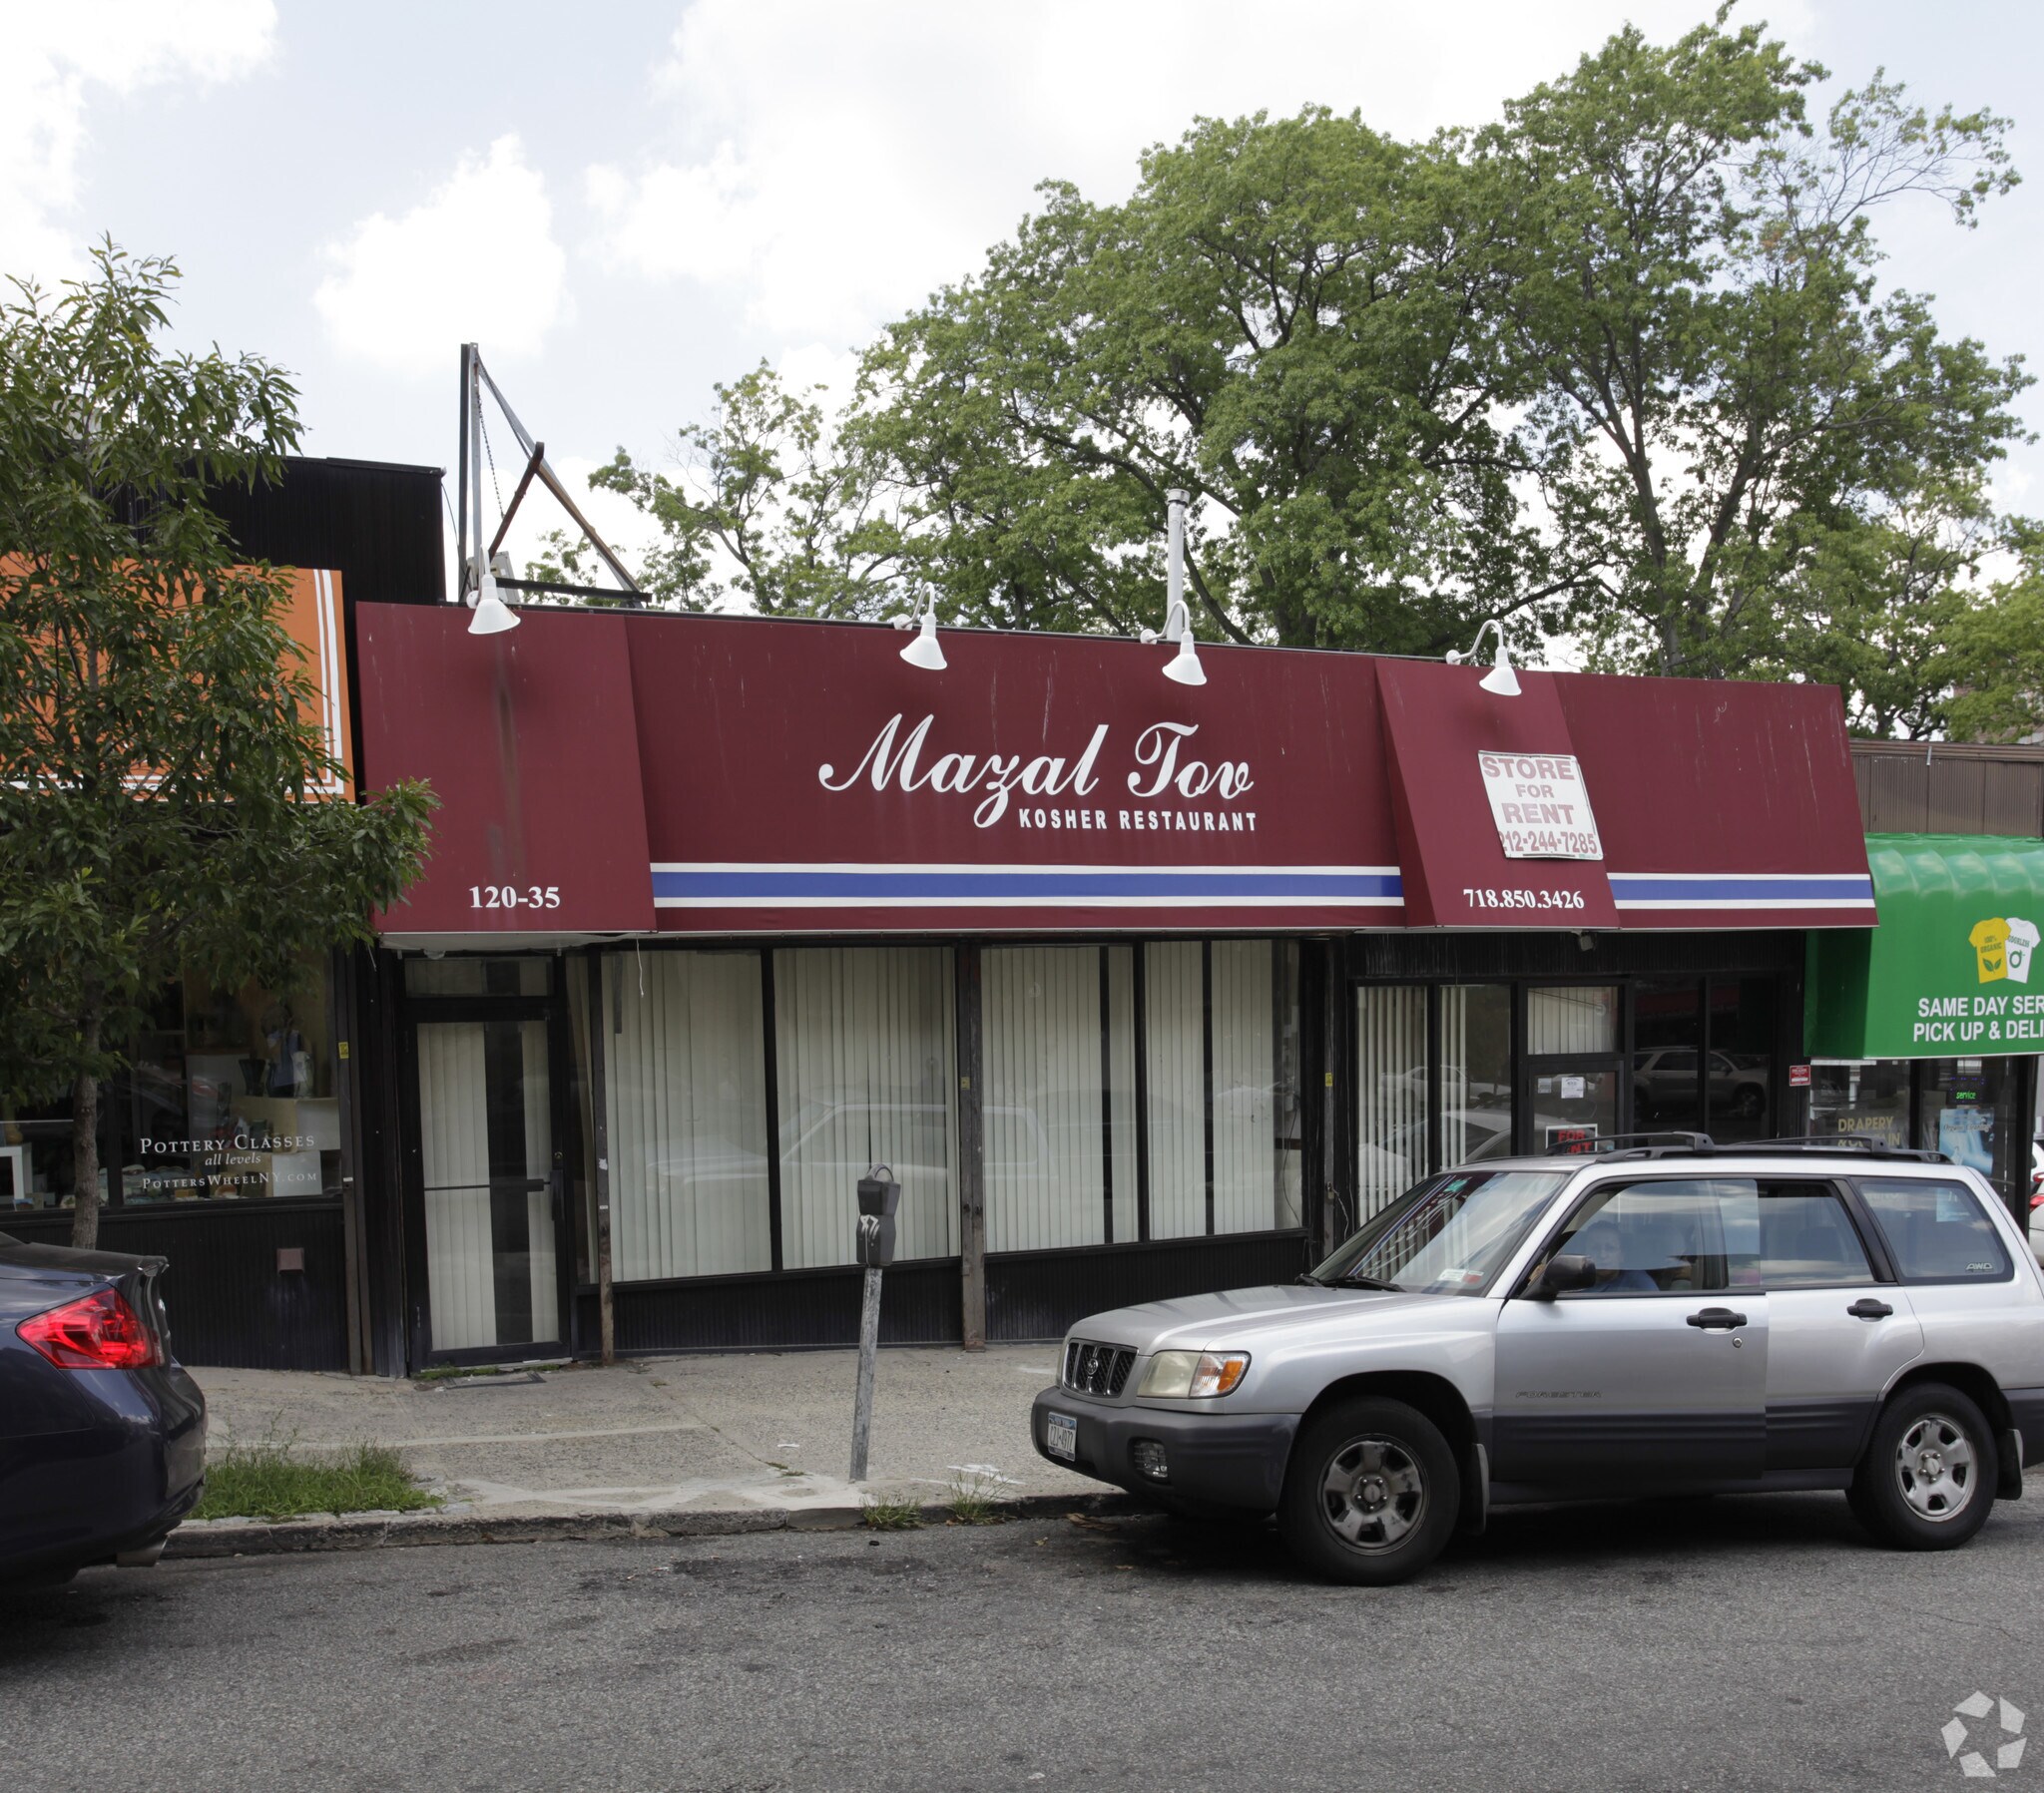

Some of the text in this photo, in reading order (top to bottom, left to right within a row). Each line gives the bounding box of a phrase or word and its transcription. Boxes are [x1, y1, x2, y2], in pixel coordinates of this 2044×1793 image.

[818, 712, 1254, 828] Mazal Tov
[1481, 756, 1575, 780] STORE
[1515, 783, 1555, 799] FOR
[1018, 808, 1258, 832] KOSHER RESTAURANT
[1501, 802, 1574, 825] RENT
[468, 885, 561, 909] 120-35
[1462, 888, 1585, 909] 718.850.3426
[1917, 995, 2044, 1018] SAME DAY SER
[1913, 1019, 2044, 1043] PICK UP & DELI
[1837, 1116, 1894, 1132] DRAPERY
[1558, 1128, 1586, 1143] FOR
[205, 1151, 261, 1166] all levels
[1965, 1262, 1993, 1271] AWD
[1515, 1390, 1602, 1399] FORESTER
